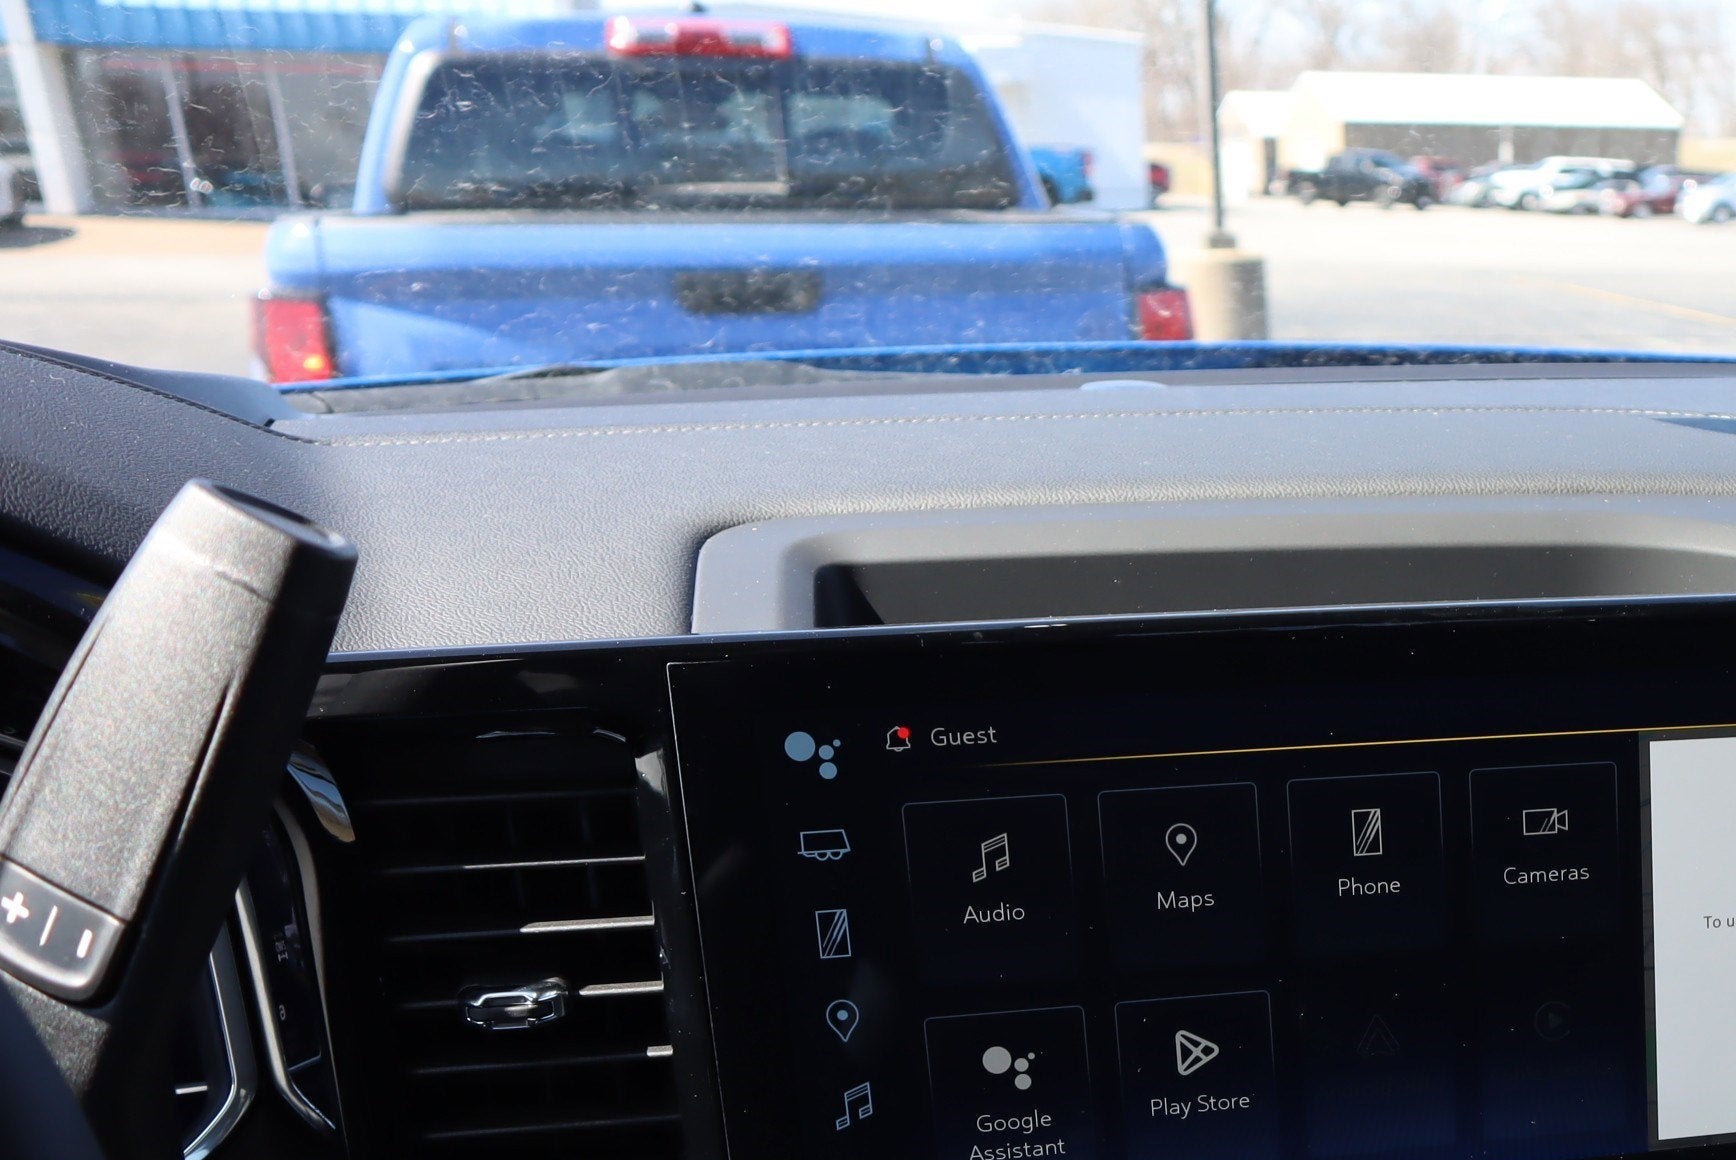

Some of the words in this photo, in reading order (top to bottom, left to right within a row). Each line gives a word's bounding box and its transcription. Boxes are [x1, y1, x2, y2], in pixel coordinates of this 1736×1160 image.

[930, 726, 998, 747] Guest
[1338, 876, 1401, 897] Phone
[1503, 866, 1590, 885] Cameras
[963, 901, 1025, 924] Audio
[1157, 890, 1215, 913] Maps
[1703, 915, 1722, 929] To
[1150, 1097, 1191, 1120] Play
[1197, 1094, 1250, 1113] Store
[976, 1108, 1052, 1135] Google
